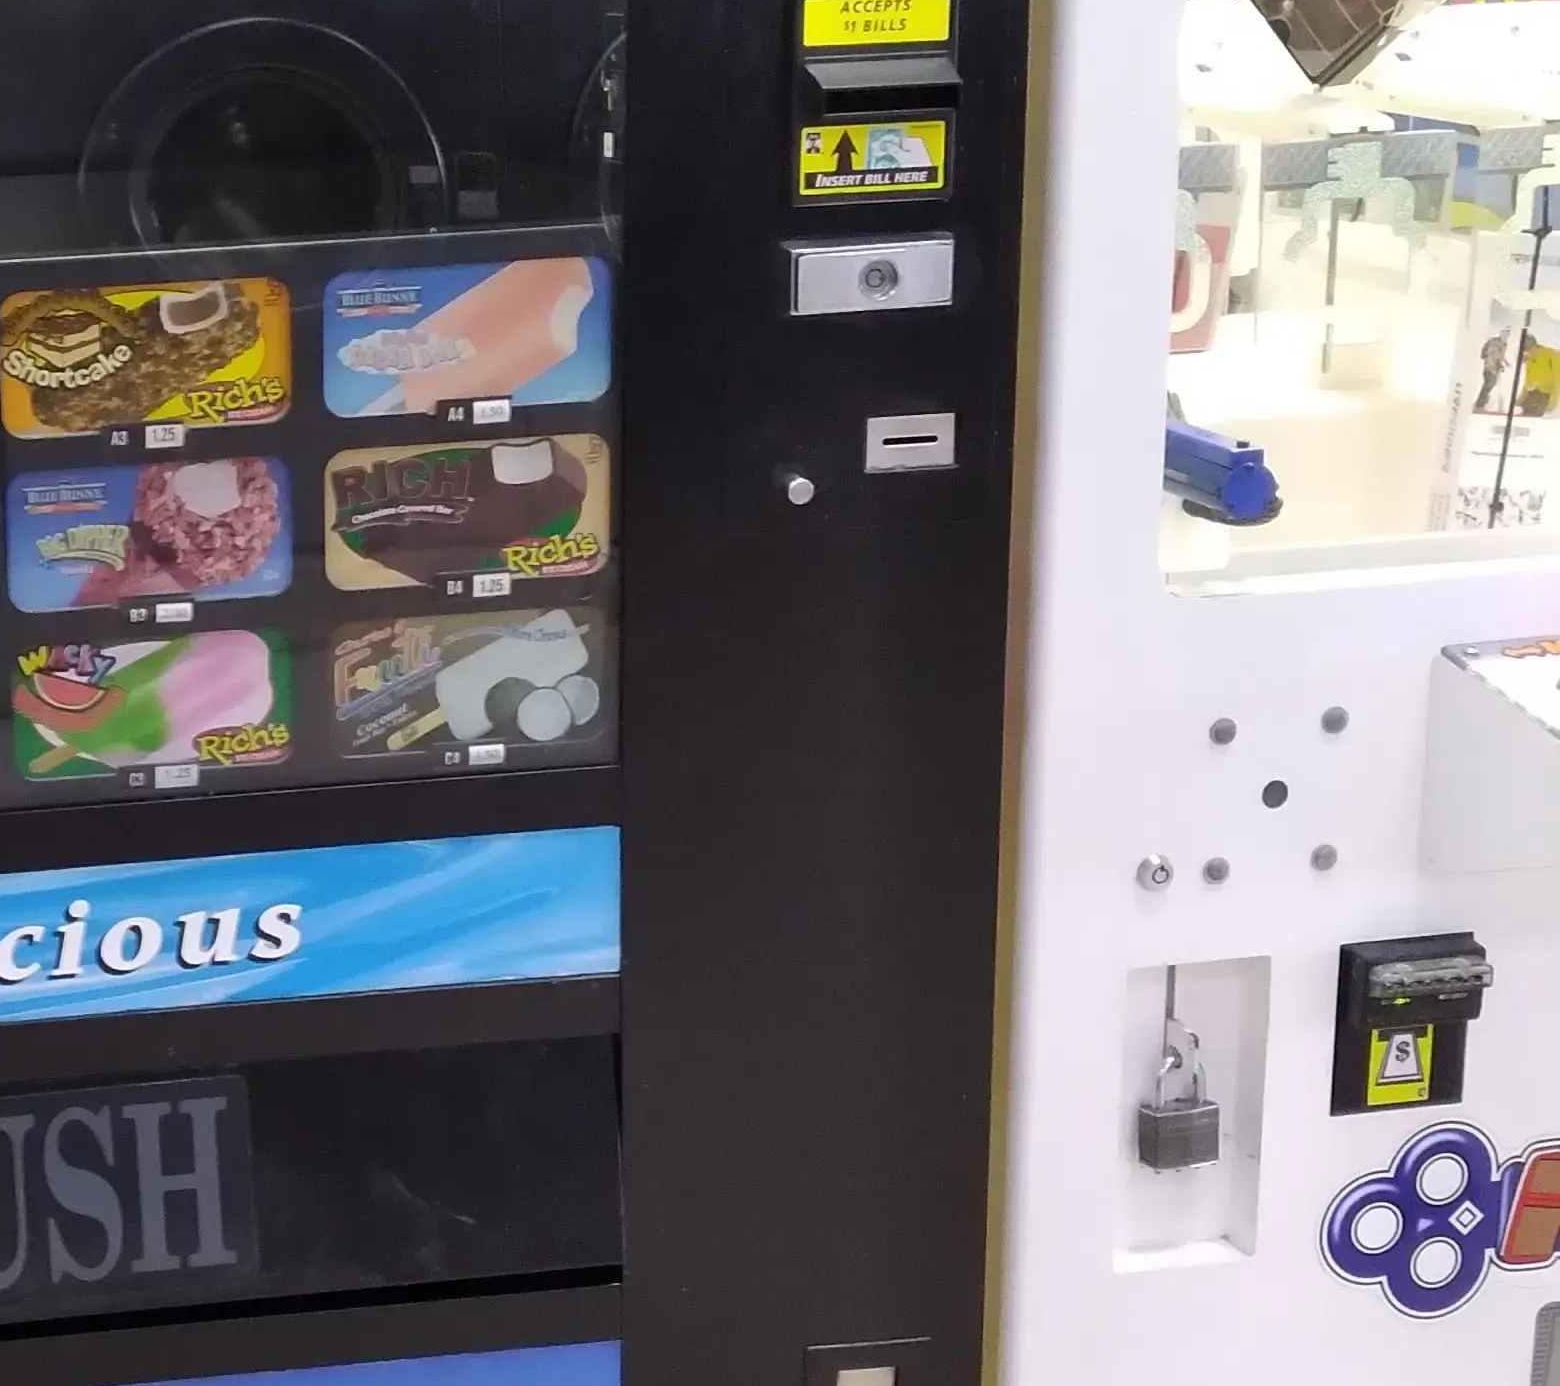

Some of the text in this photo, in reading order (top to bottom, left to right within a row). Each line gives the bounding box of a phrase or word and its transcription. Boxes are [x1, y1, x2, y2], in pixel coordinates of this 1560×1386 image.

[863, 18, 907, 33] BILLS
[815, 170, 928, 188] INSERT BILL HERE
[3, 344, 134, 389] Shortcake
[447, 406, 466, 422] A4
[151, 426, 176, 443] 1.25
[479, 579, 504, 594] 1.25
